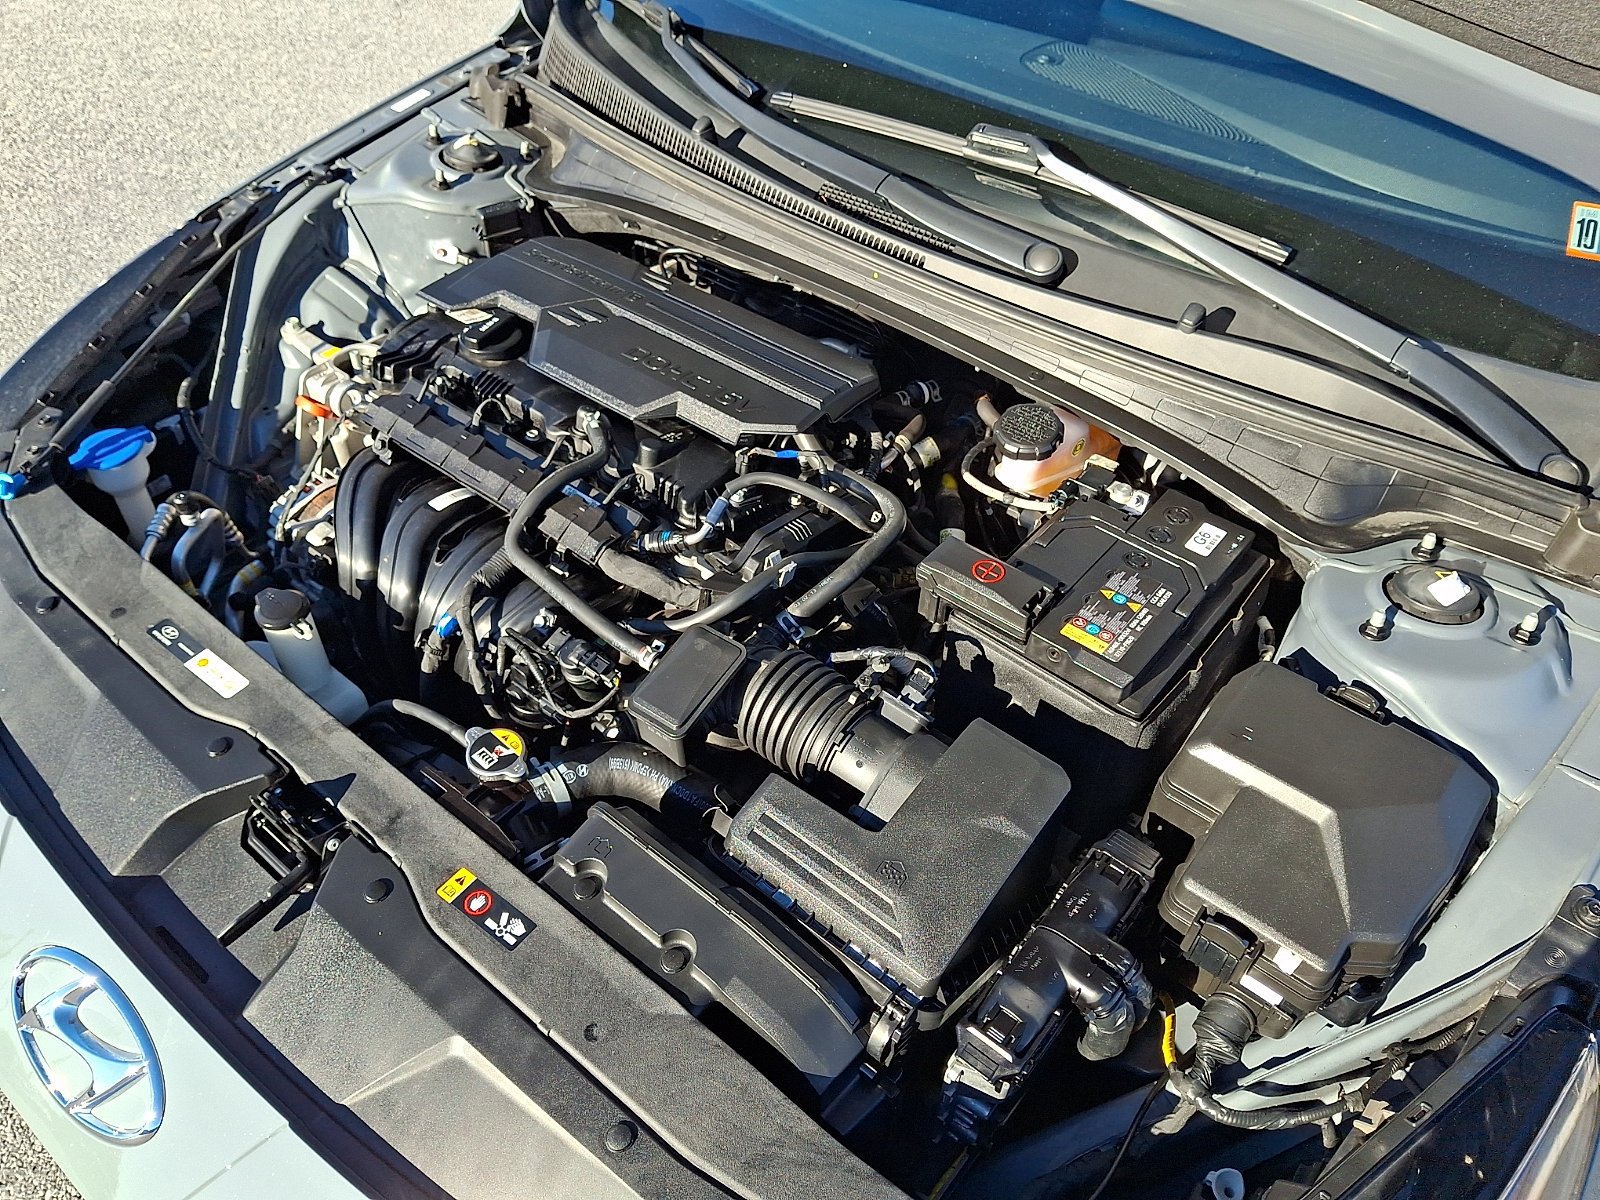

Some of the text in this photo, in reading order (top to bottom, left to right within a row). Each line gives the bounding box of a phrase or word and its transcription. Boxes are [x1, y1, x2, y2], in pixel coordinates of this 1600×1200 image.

[620, 346, 767, 413] DOHC 16V
[1193, 531, 1211, 545] G6
